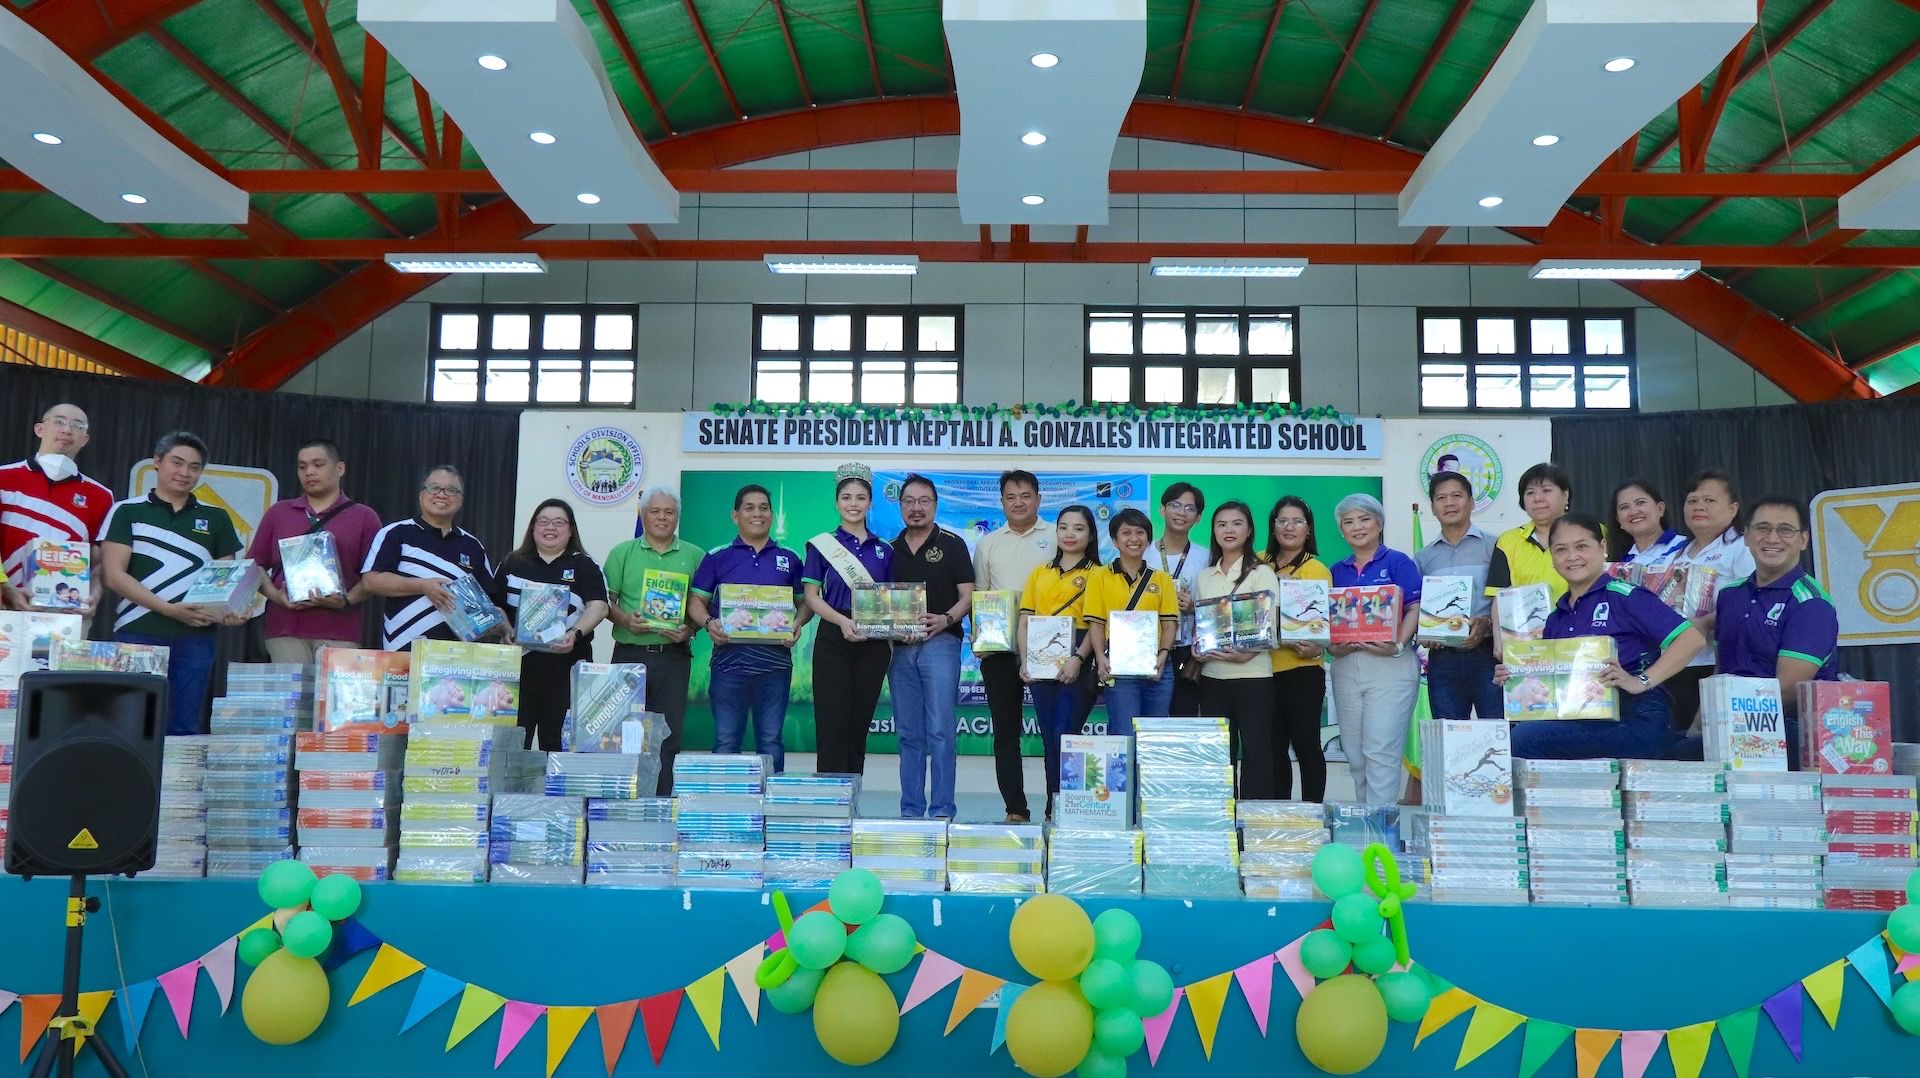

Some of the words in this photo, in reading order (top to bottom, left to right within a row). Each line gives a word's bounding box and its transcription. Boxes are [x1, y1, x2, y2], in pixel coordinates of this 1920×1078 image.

[699, 418, 778, 445] SENATE
[784, 418, 902, 447] PRESIDENT
[907, 419, 993, 447] NEPTALI
[998, 420, 1018, 448] A.
[1023, 420, 1132, 448] GONZALES
[1139, 421, 1272, 450] INTEGRATED
[1278, 422, 1367, 451] SCHOOL
[569, 434, 591, 466] SCHOOLS
[591, 429, 627, 442] DIVISION
[627, 440, 641, 466] OFFICE
[573, 479, 584, 491] CITY
[592, 480, 636, 501] MANDALUYONG
[647, 578, 686, 591] ENGLISH
[525, 598, 558, 631] Computers
[1061, 618, 1070, 629] 5
[387, 672, 408, 680] Food
[422, 664, 472, 676] Caregiving
[472, 667, 521, 679] Caregiving
[585, 683, 631, 736] Computers
[1731, 697, 1778, 713] ENGLISH
[1744, 712, 1779, 732] WAY
[1826, 711, 1863, 728] English
[1495, 724, 1507, 741] 5
[1854, 728, 1874, 739] This
[1839, 739, 1872, 759] Way
[1064, 792, 1093, 802] Soaring
[1064, 808, 1118, 817] MATHEMATICS
